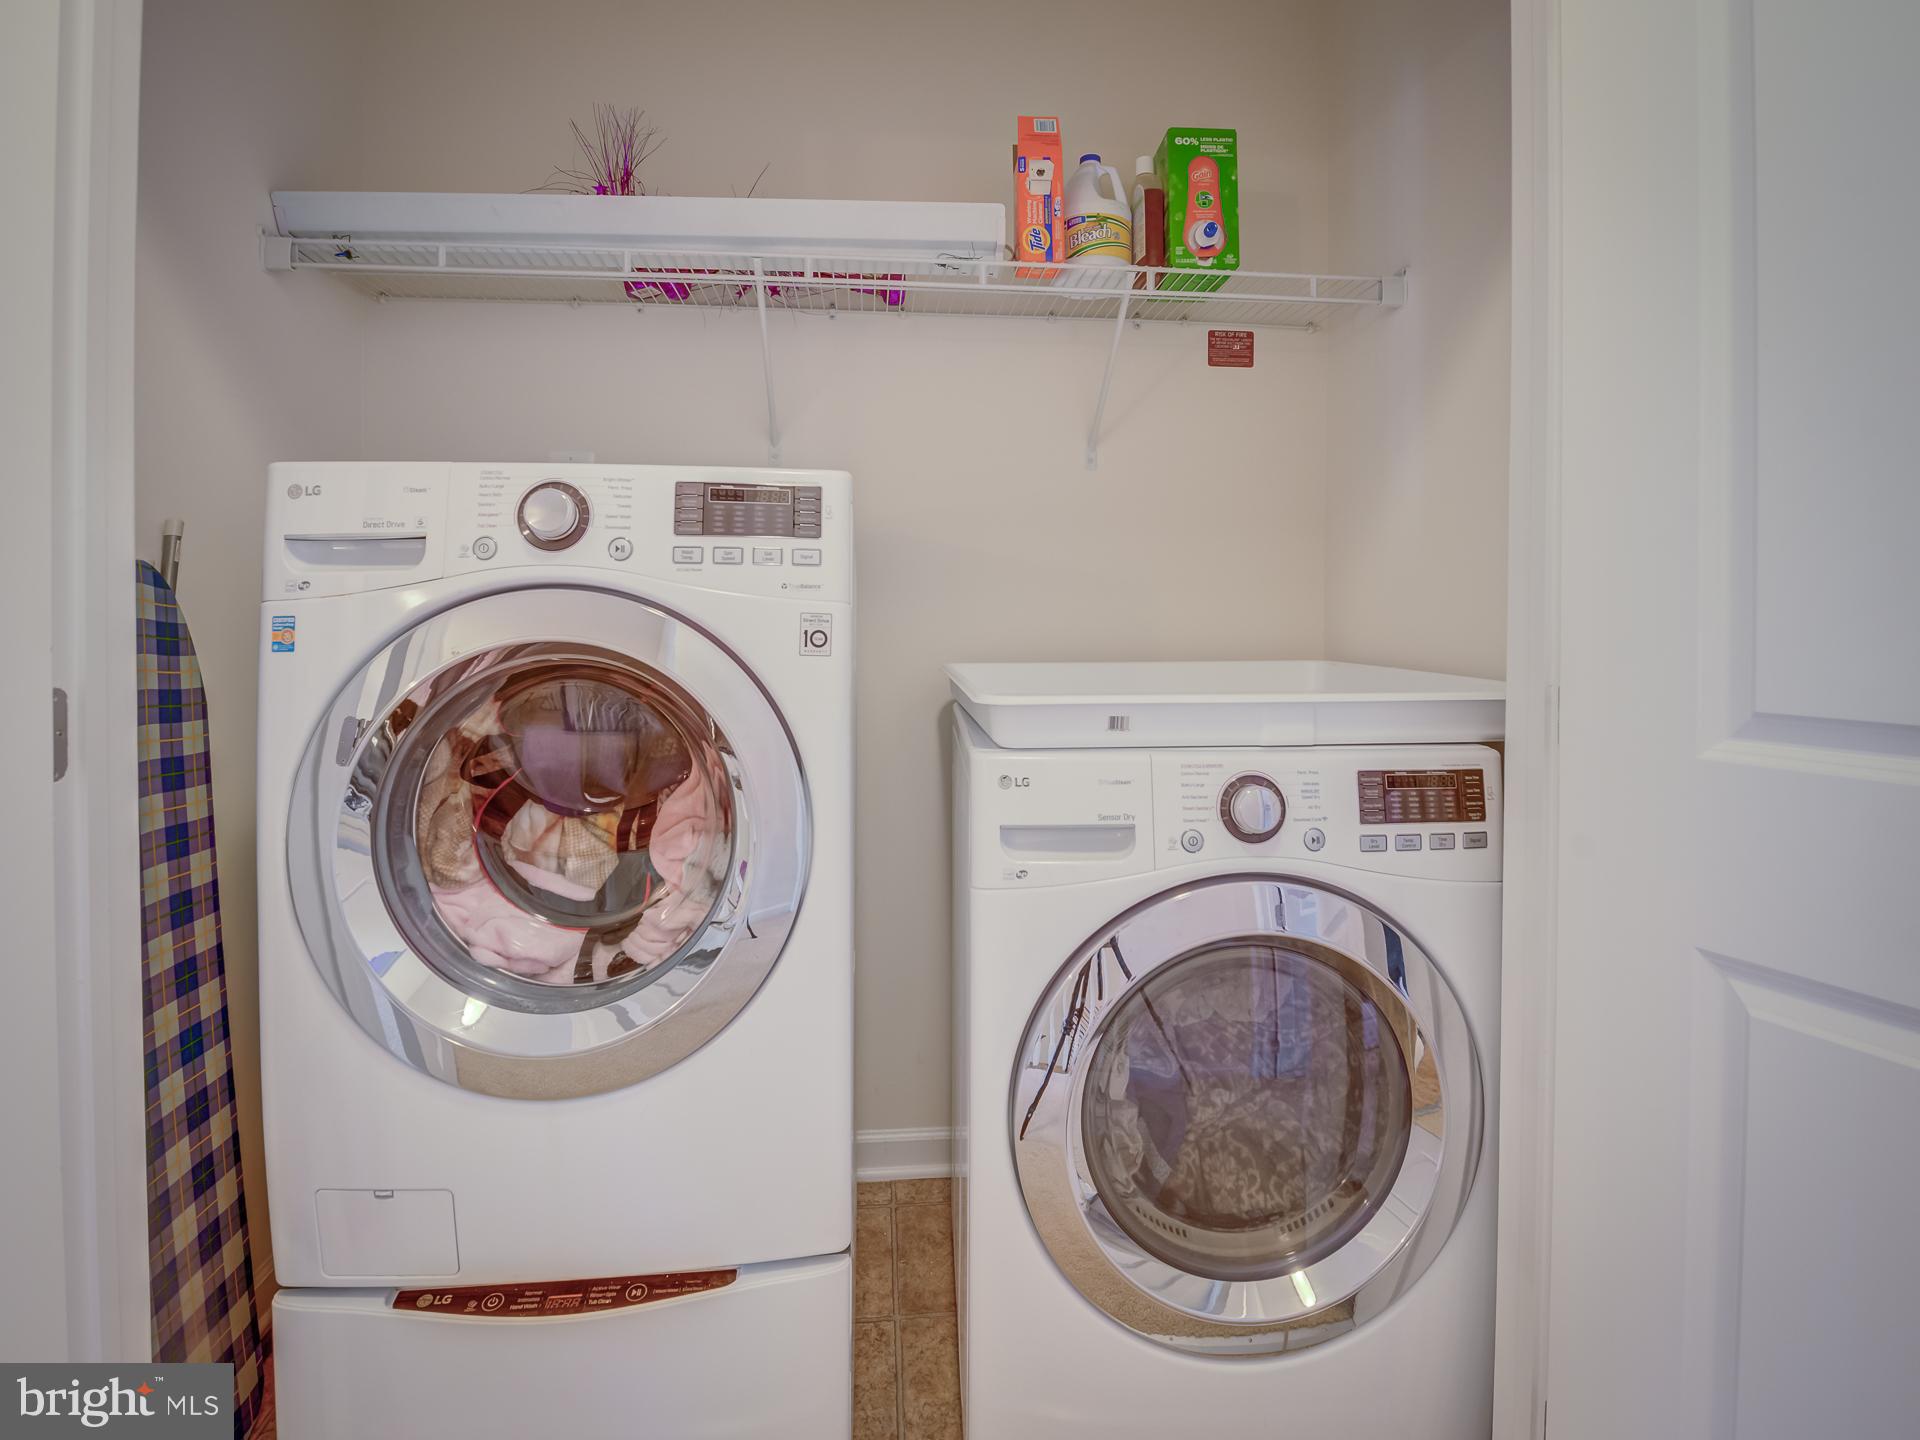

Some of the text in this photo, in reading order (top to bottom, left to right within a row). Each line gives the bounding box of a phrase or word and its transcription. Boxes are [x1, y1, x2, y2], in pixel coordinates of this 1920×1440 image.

[1174, 136, 1199, 146] 60%
[1029, 227, 1046, 252] Tide
[1070, 223, 1112, 249] Bleach
[305, 485, 321, 496] LG
[362, 520, 406, 528] Direct Drive
[804, 630, 828, 648] 10
[1014, 777, 1030, 788] LG
[1098, 813, 1136, 822] Sensor Dry
[434, 1294, 453, 1305] LG
